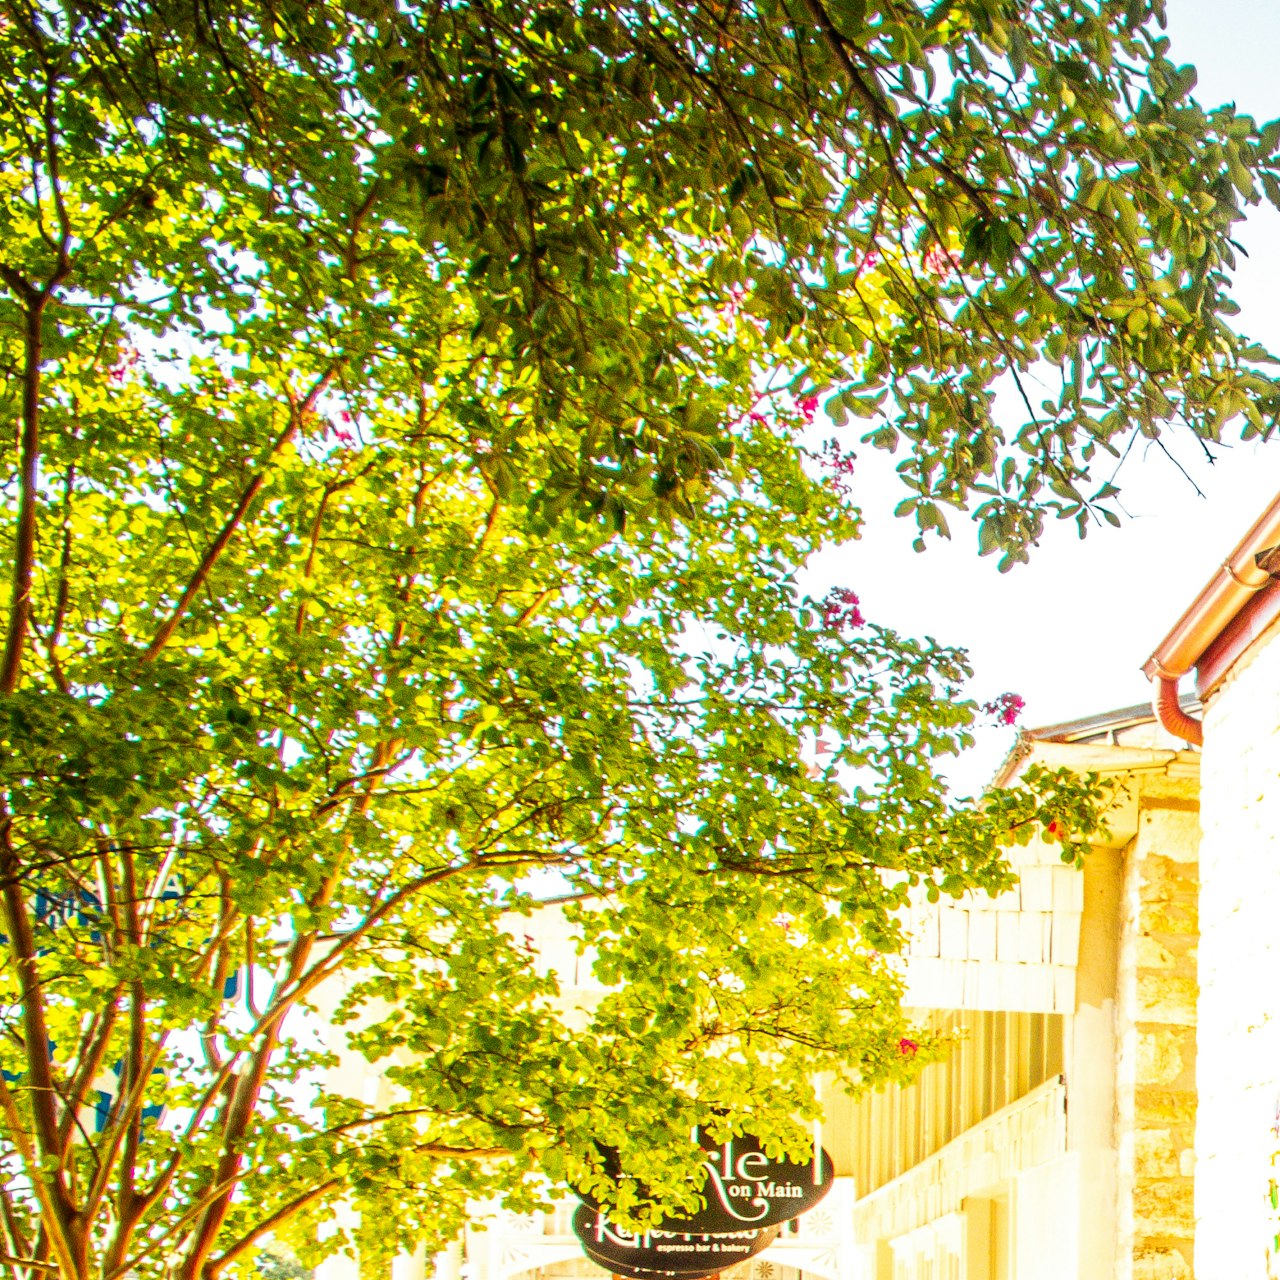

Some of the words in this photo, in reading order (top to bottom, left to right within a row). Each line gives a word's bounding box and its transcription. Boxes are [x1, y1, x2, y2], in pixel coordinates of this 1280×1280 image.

[728, 1185, 751, 1198] on
[756, 1183, 803, 1198] Main
[656, 1244, 695, 1253] espresso
[695, 1243, 711, 1252] bar
[711, 1243, 720, 1252] &
[720, 1243, 751, 1254] bakery
